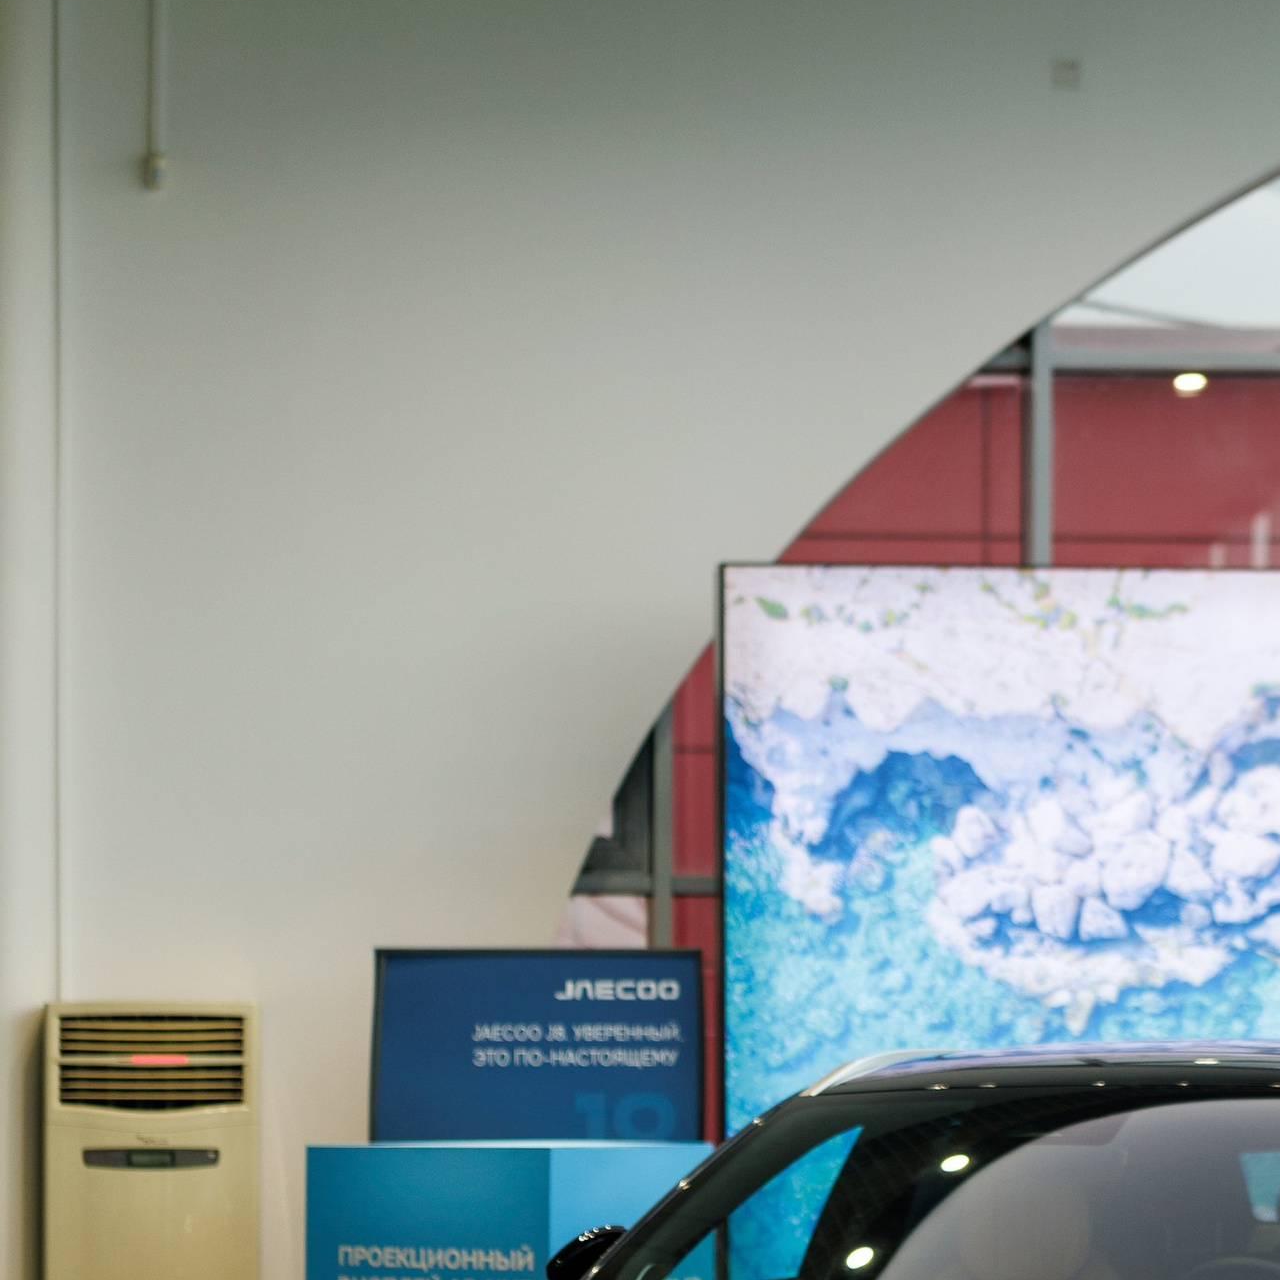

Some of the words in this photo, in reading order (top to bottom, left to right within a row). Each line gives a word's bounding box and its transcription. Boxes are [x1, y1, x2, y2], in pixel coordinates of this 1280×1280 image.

[554, 979, 680, 1001] JAECOO
[471, 1024, 541, 1042] JAECOO
[472, 1049, 510, 1067] ЭТО
[513, 1048, 679, 1069] ПО-НАСТОЯЩЕМУ
[337, 1244, 535, 1273] ПРОЕКЦИОННЫЙ
